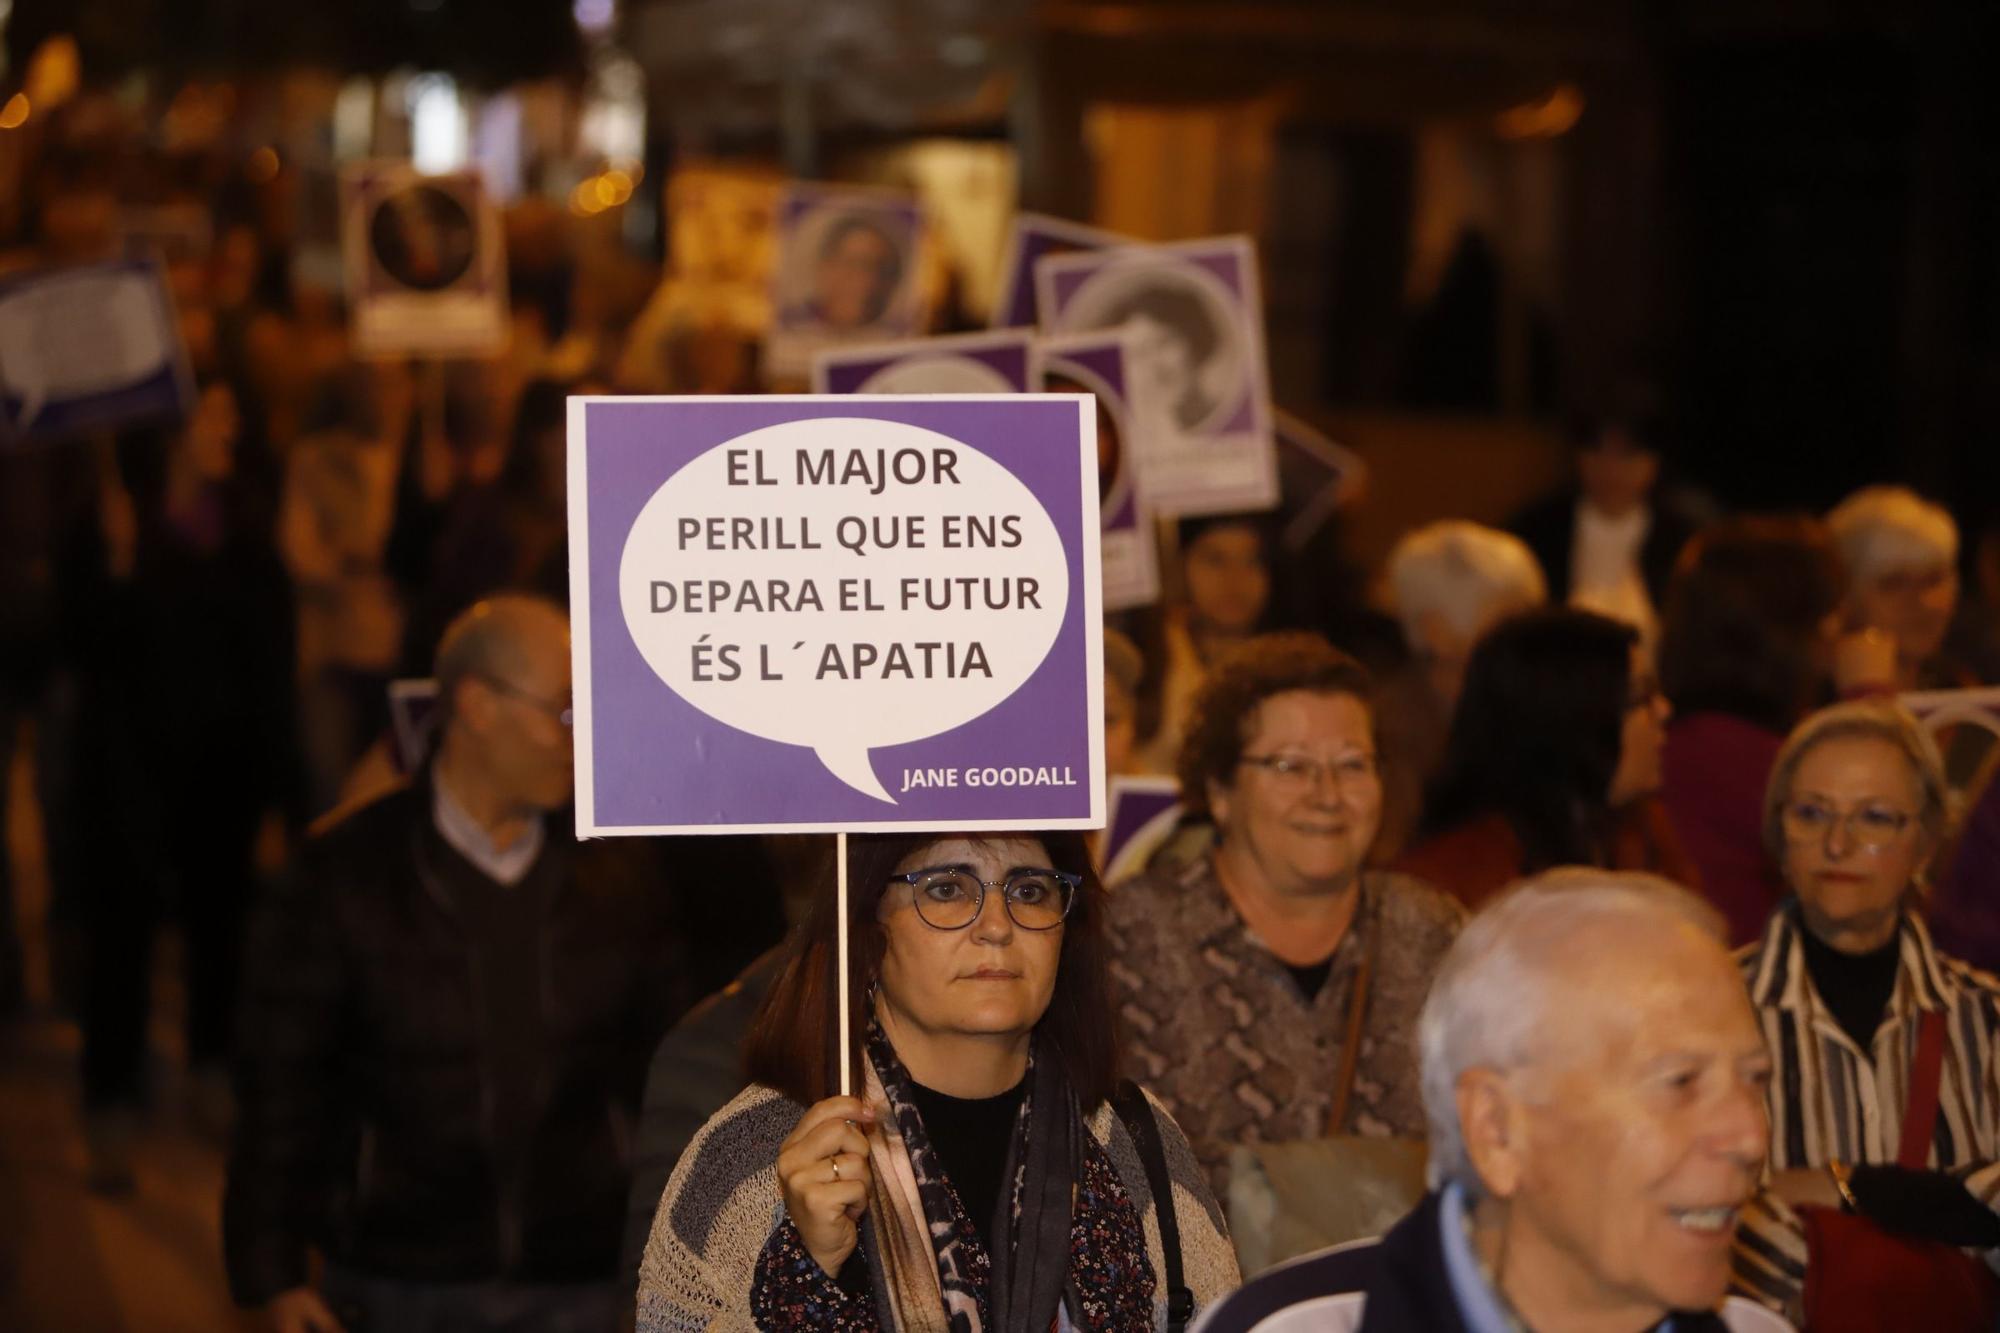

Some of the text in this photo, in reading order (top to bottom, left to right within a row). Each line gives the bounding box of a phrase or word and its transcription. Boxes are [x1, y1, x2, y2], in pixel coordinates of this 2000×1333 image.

[727, 447, 961, 496] EL MAJOR
[678, 514, 1023, 557] PERILL QUE ENS
[650, 577, 1042, 614] DEPARA EL FUTUR
[691, 634, 742, 682] ÉS
[901, 766, 1077, 793] JANE GOODALL
